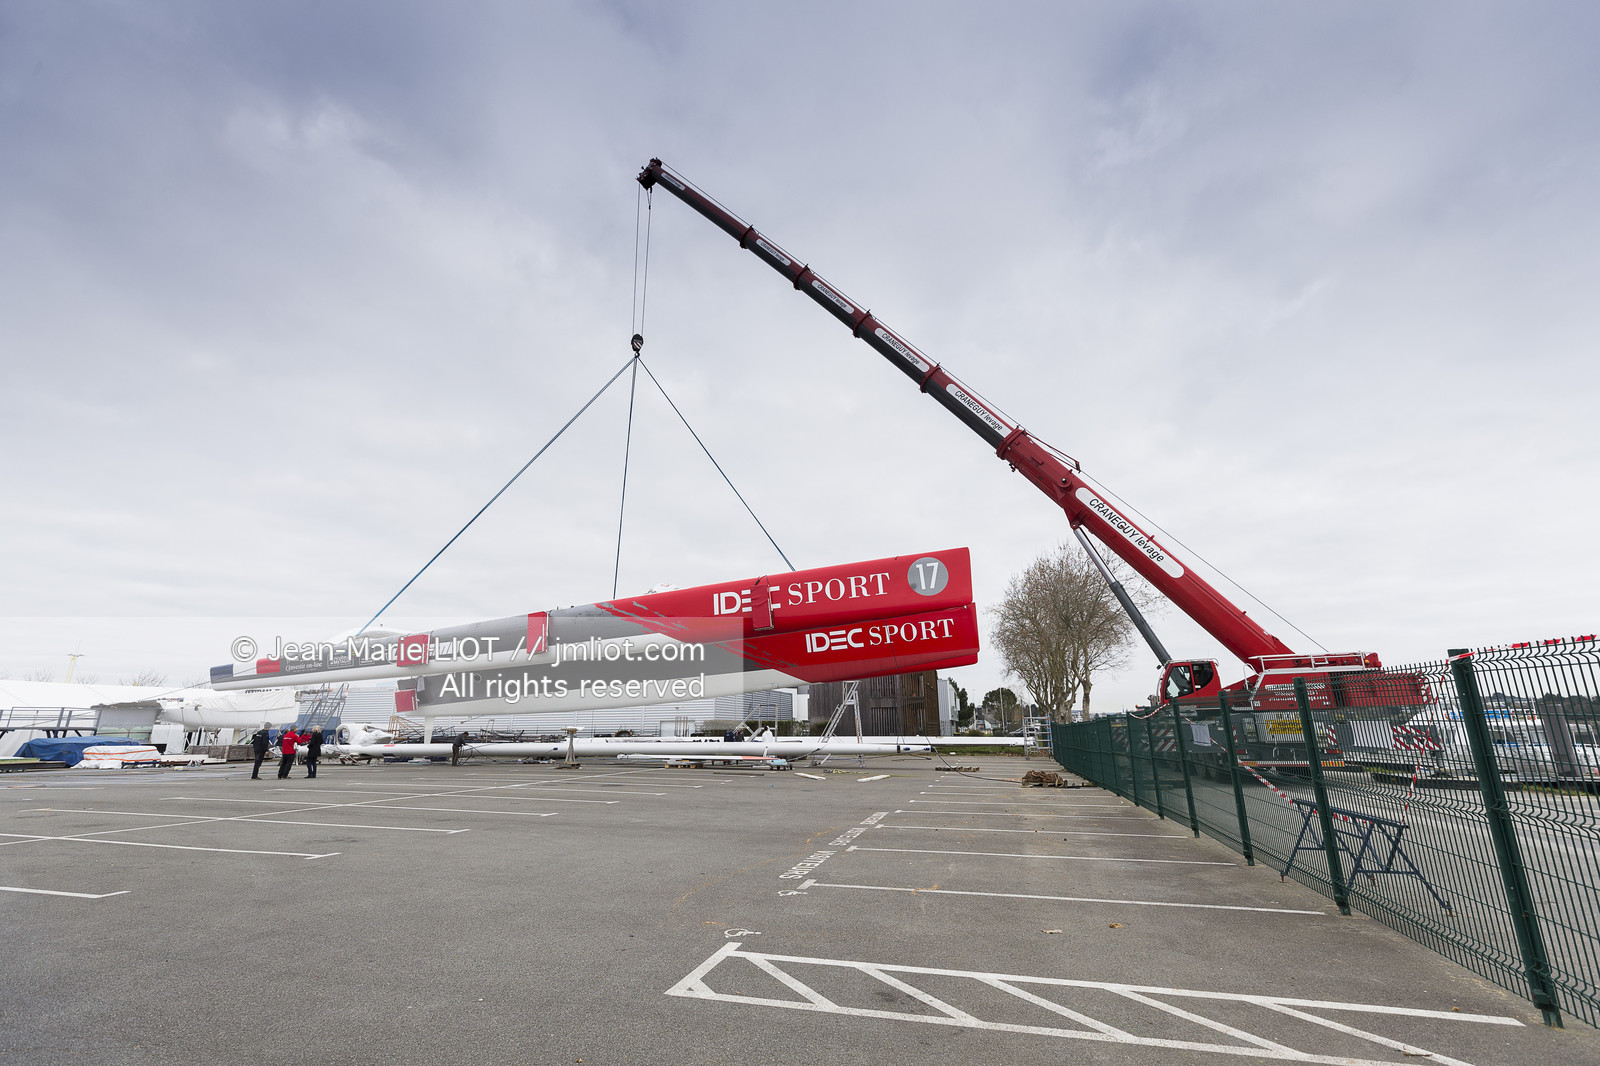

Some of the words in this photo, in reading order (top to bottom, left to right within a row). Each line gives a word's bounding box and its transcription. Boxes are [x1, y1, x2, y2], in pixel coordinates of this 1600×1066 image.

[881, 332, 907, 353] CRANEGUY
[954, 390, 987, 416] CRANEGUY
[983, 413, 1003, 431] levage
[1089, 498, 1139, 539] CRANEGUY
[1134, 536, 1165, 562] levage
[787, 572, 891, 607] SPORT
[915, 561, 940, 590] 17
[805, 627, 865, 653] IDEC
[868, 618, 955, 647] SPORT
